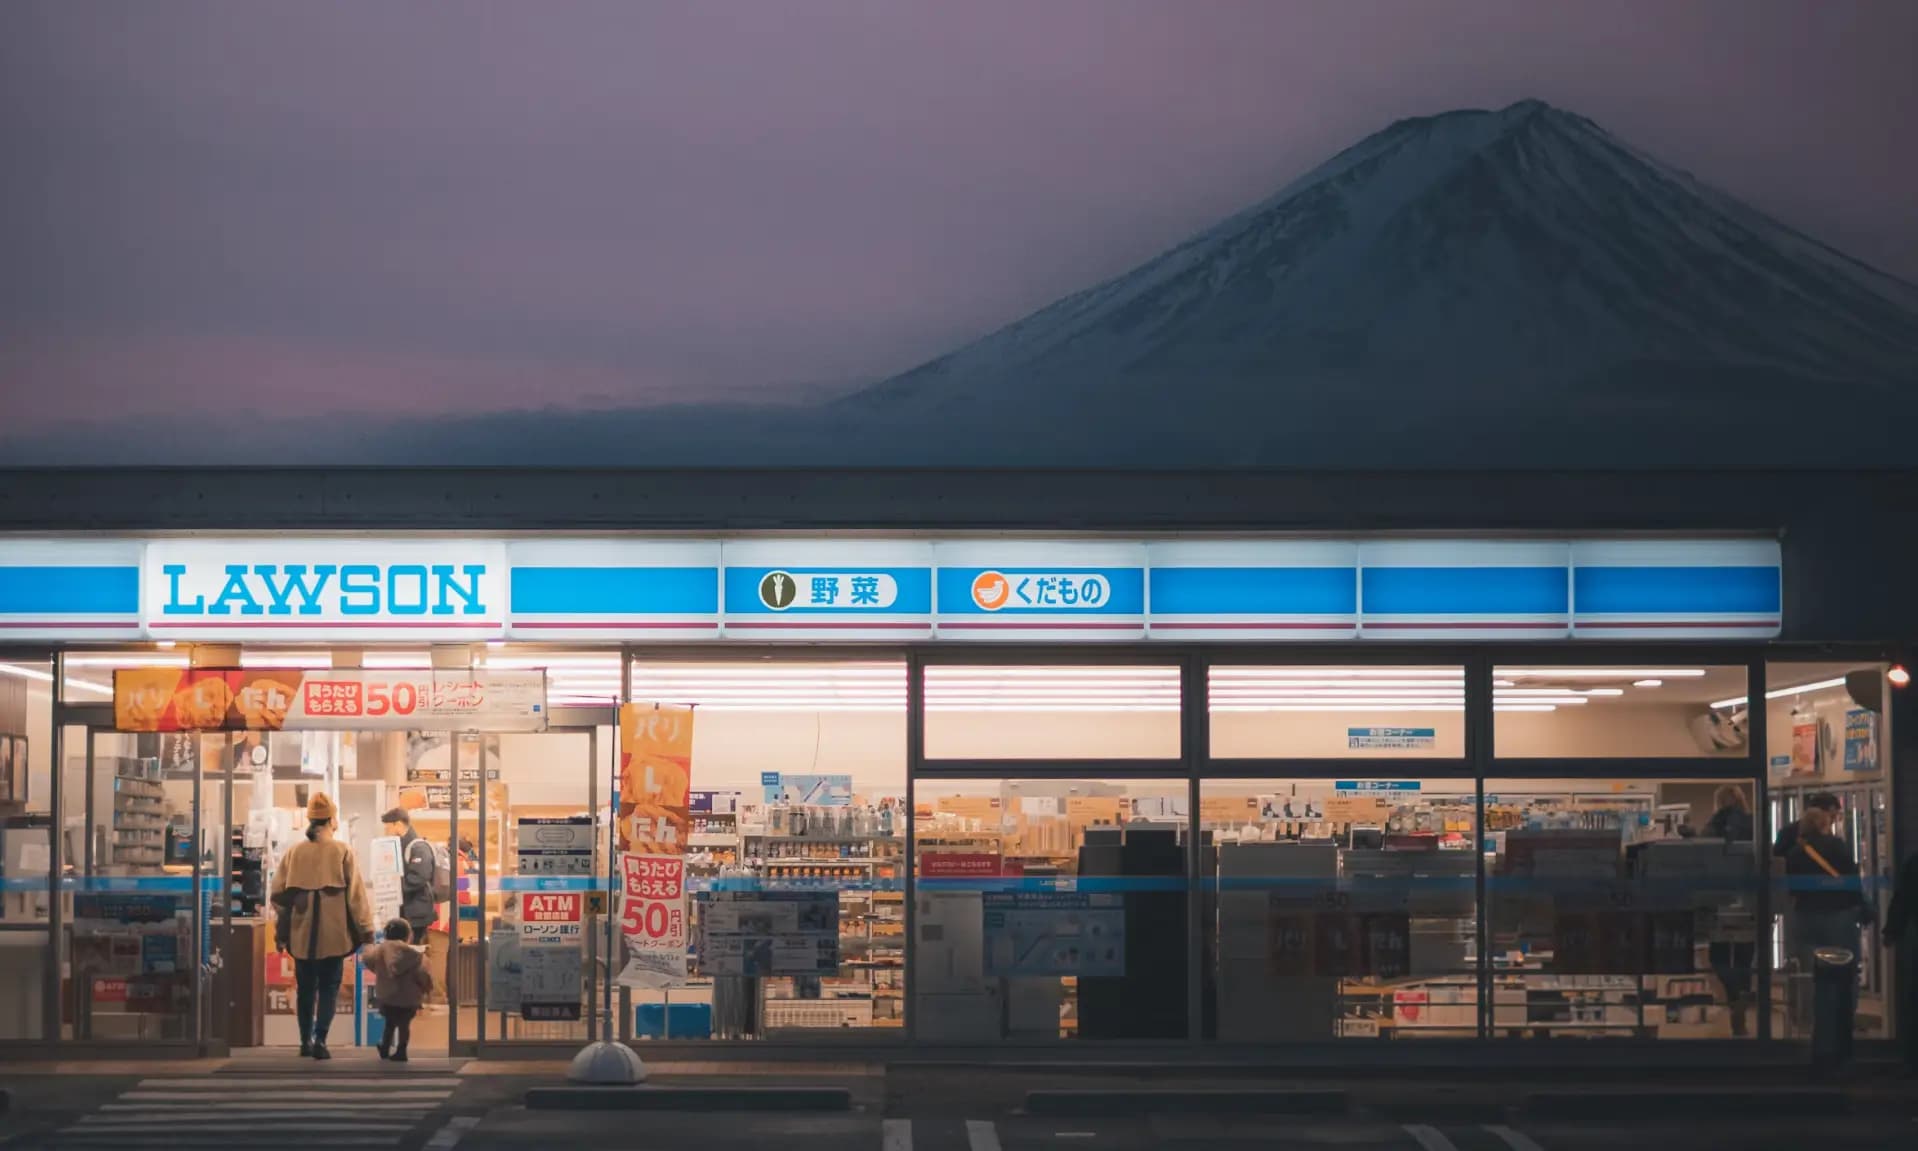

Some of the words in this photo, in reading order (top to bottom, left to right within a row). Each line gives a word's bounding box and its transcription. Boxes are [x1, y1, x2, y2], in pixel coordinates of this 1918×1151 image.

[163, 565, 486, 615] LAWSON
[811, 577, 879, 604] 野菜
[1015, 577, 1101, 604] くだもの
[309, 684, 358, 698] 買うたび
[432, 680, 484, 694] レシート
[309, 699, 358, 713] もらえる
[366, 682, 417, 715] 50
[433, 696, 484, 708] クーポン
[626, 858, 679, 878] 買うたび
[628, 877, 679, 896] もらえる
[529, 895, 574, 911] ATM
[622, 898, 669, 938] 50
